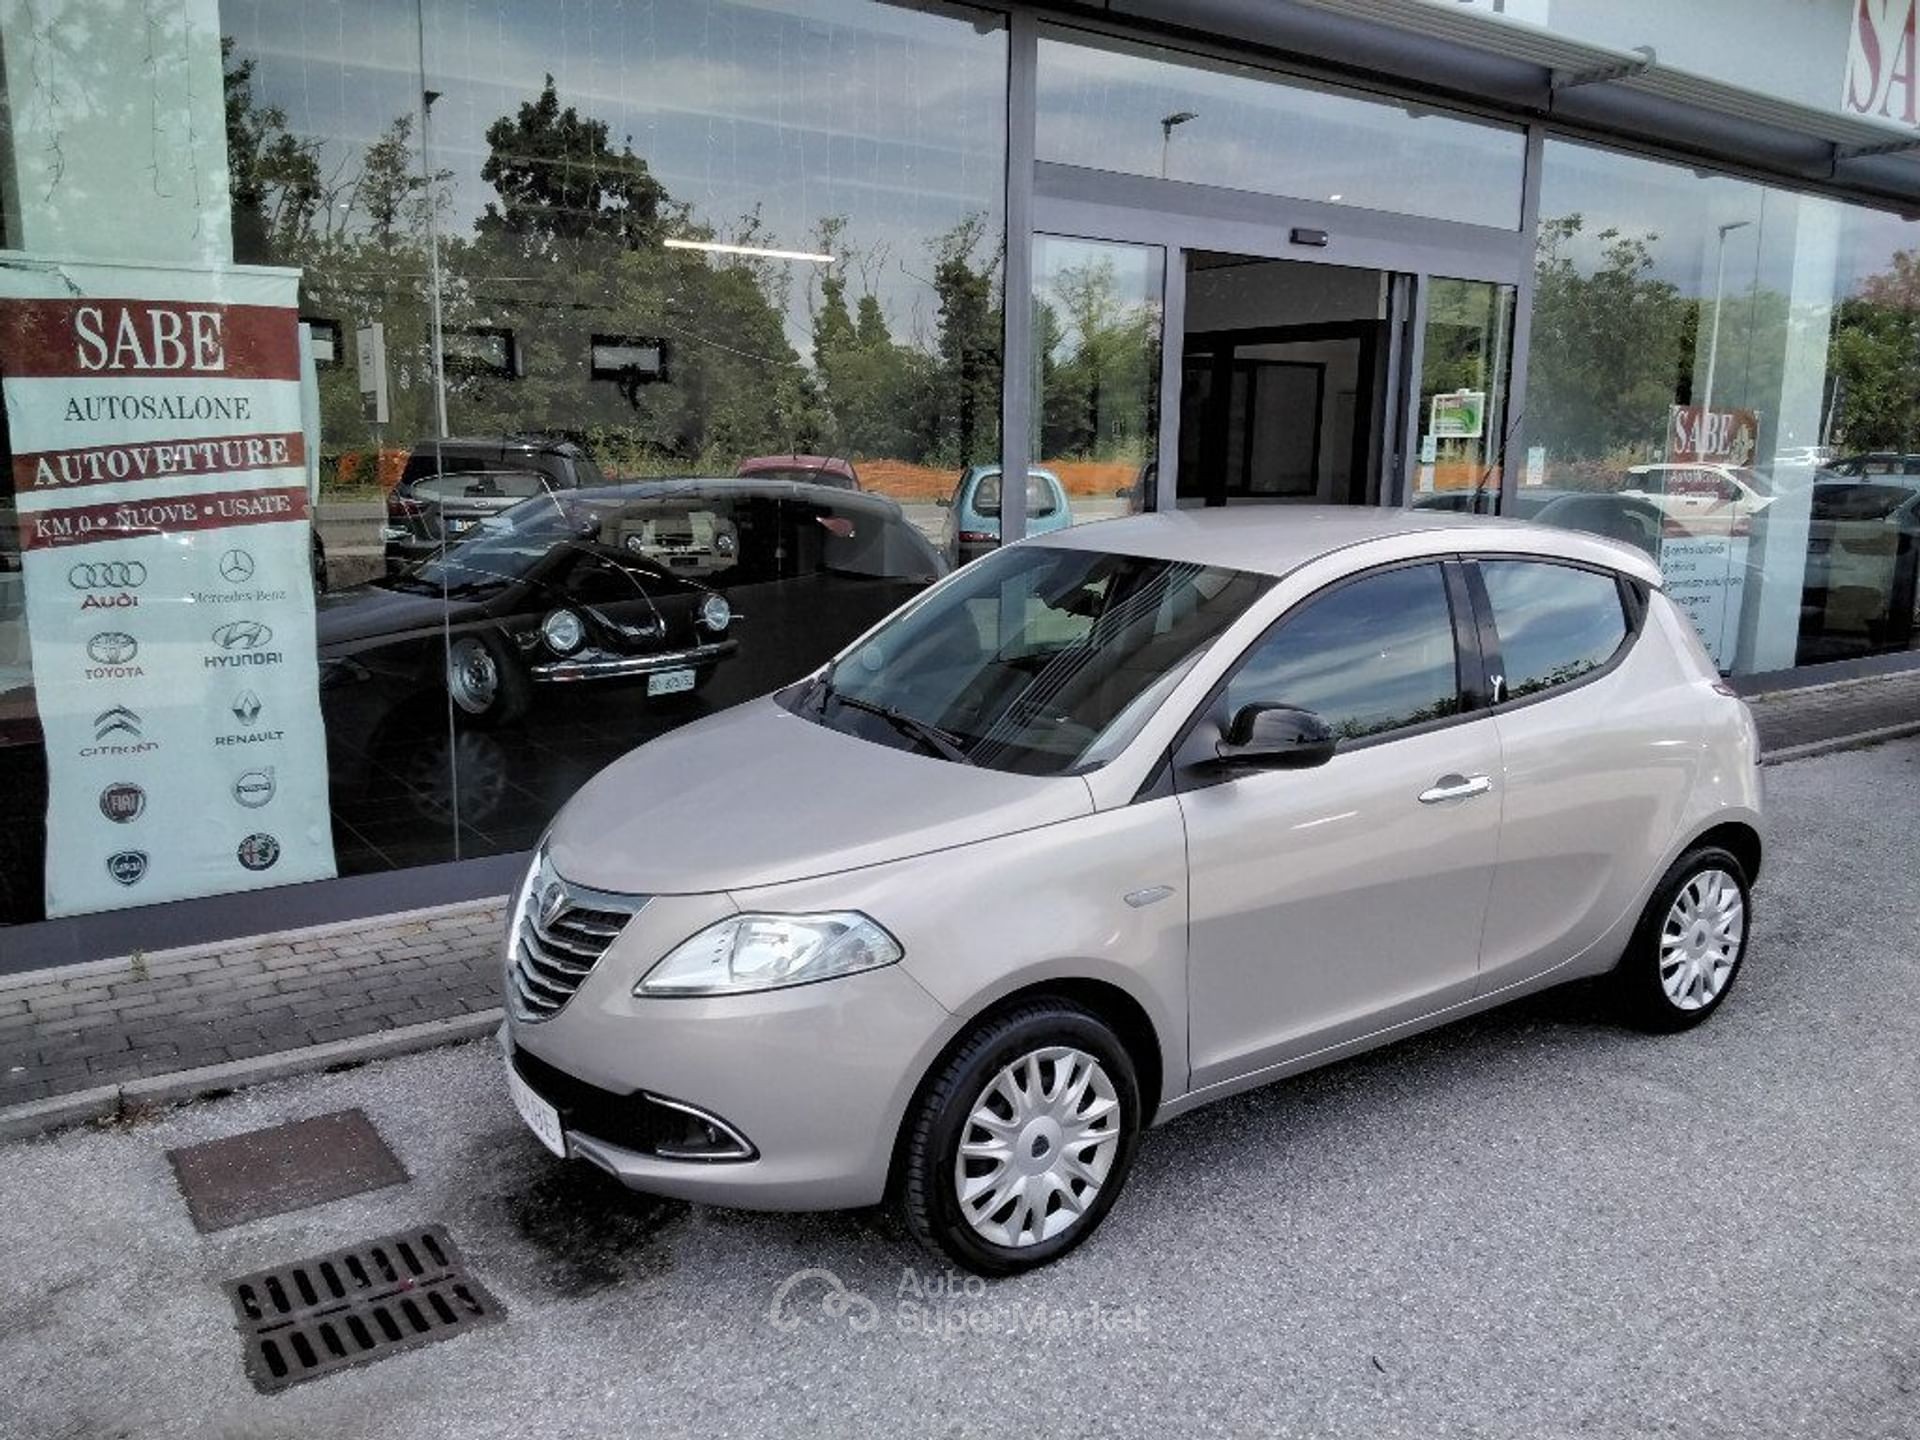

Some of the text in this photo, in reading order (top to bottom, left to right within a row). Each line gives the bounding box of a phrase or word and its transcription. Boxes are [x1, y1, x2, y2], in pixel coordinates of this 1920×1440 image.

[75, 307, 225, 371] SABE
[64, 396, 251, 422] AUTOSALONE
[1674, 410, 1734, 454] SABE
[34, 438, 290, 487] AUTOVETTURE
[115, 504, 198, 529] NUOVE
[218, 494, 291, 517] USATE
[81, 592, 139, 610] Audi
[204, 652, 283, 668] HYUNDAI
[85, 666, 145, 680] TOYOTA
[215, 731, 285, 746] RENAULT
[111, 793, 137, 812] FIAT
